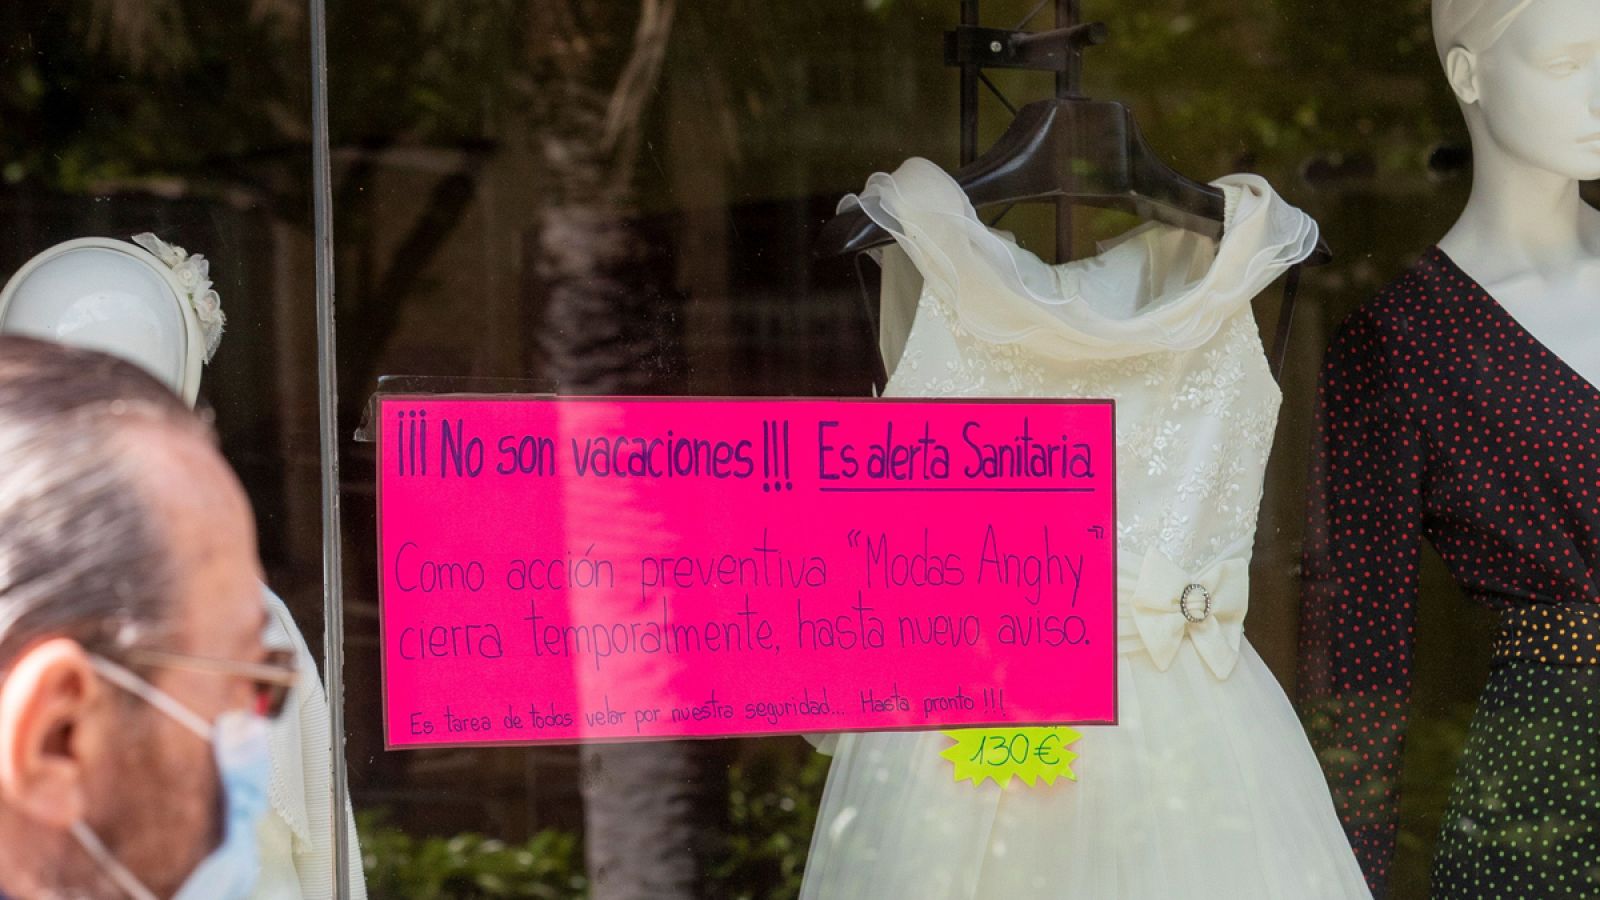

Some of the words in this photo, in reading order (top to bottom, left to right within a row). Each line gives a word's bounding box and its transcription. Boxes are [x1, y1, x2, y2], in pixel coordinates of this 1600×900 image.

[497, 435, 555, 475] son
[819, 421, 858, 480] Es
[867, 421, 949, 480] alerta
[963, 417, 1094, 479] Sanitaria
[394, 542, 485, 592] Como
[507, 544, 615, 591] acción
[641, 528, 827, 602] preventiva
[400, 621, 503, 660] cierra
[524, 591, 780, 671] temporalmente,
[798, 592, 884, 650] hasta
[899, 615, 980, 647] nuevo
[998, 611, 1089, 646] aviso.
[411, 712, 433, 735] Es
[445, 706, 491, 731] tarea
[504, 706, 522, 728] de
[530, 703, 573, 728] todos
[586, 695, 626, 726] velar
[634, 708, 659, 732] por
[672, 689, 733, 721] nuestra
[860, 683, 909, 713] Hasta
